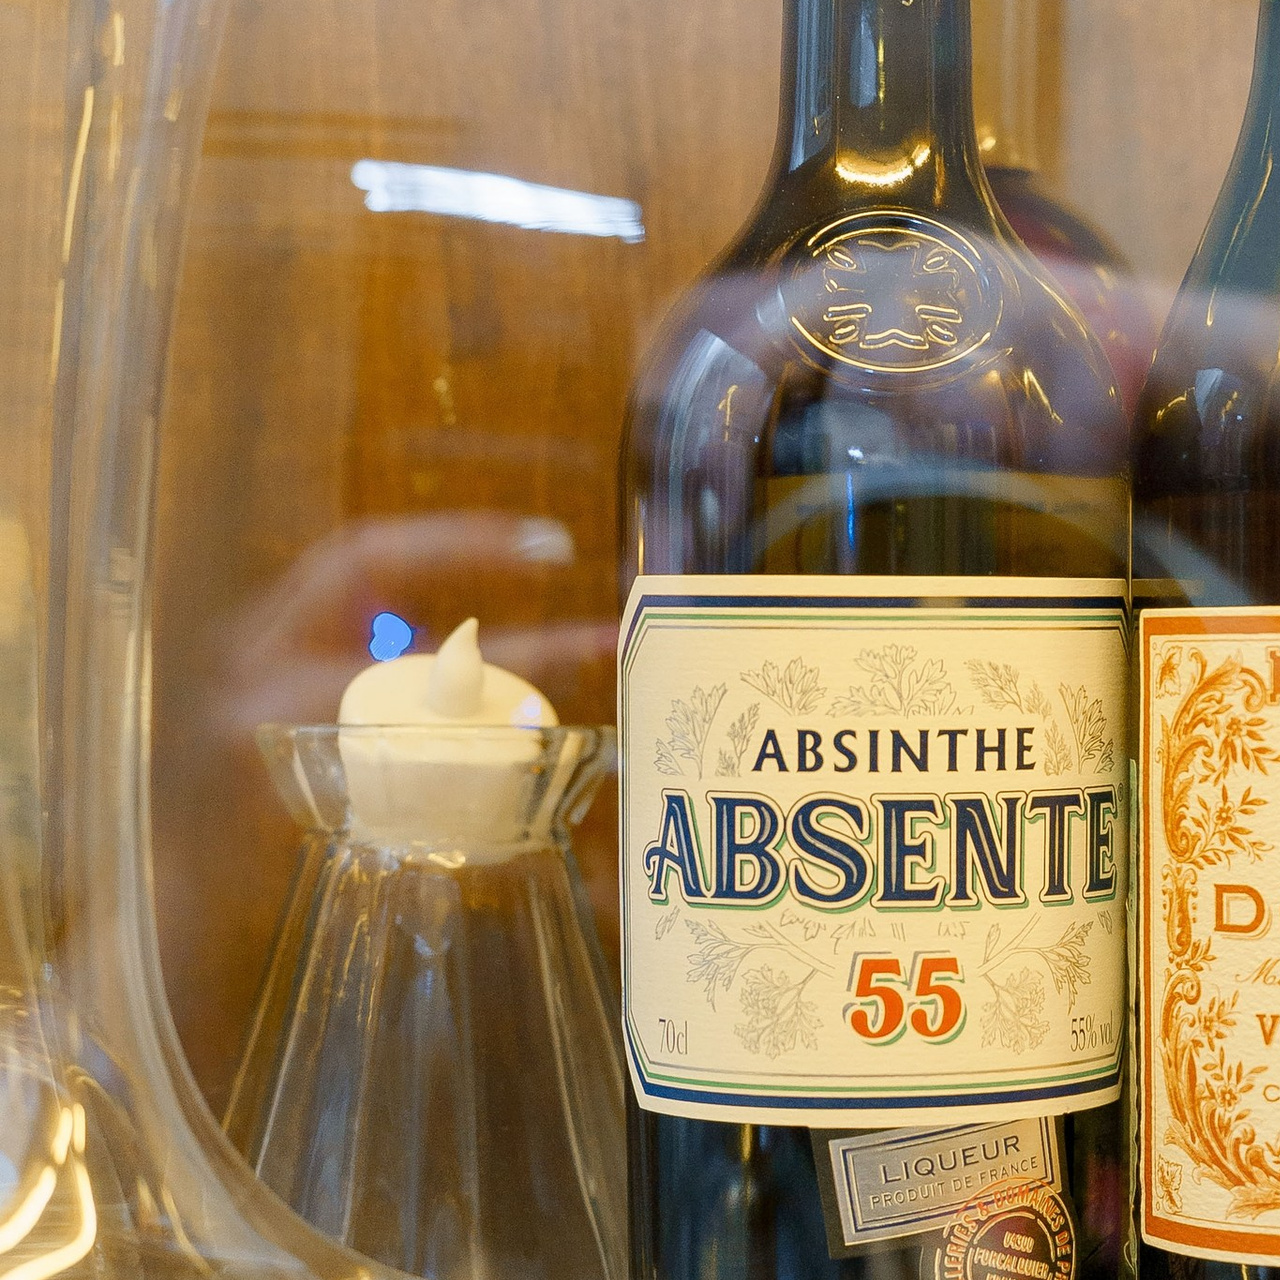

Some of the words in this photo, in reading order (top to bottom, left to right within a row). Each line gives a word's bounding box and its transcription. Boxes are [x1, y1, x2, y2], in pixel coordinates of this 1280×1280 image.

[752, 727, 1037, 773] ABSINTHE
[643, 786, 1120, 910] ABSENTE
[844, 950, 967, 1046] 55
[658, 1019, 688, 1056] 70cl
[1071, 1013, 1097, 1052] 55%
[870, 1182, 945, 1210] PRODUIT
[952, 1176, 973, 1192] DE
[979, 1155, 1039, 1185] FRANCE
[880, 1135, 1021, 1184] LIQUEUR
[993, 1185, 1065, 1232] DOMAINES
[1055, 1230, 1071, 1258] DE
